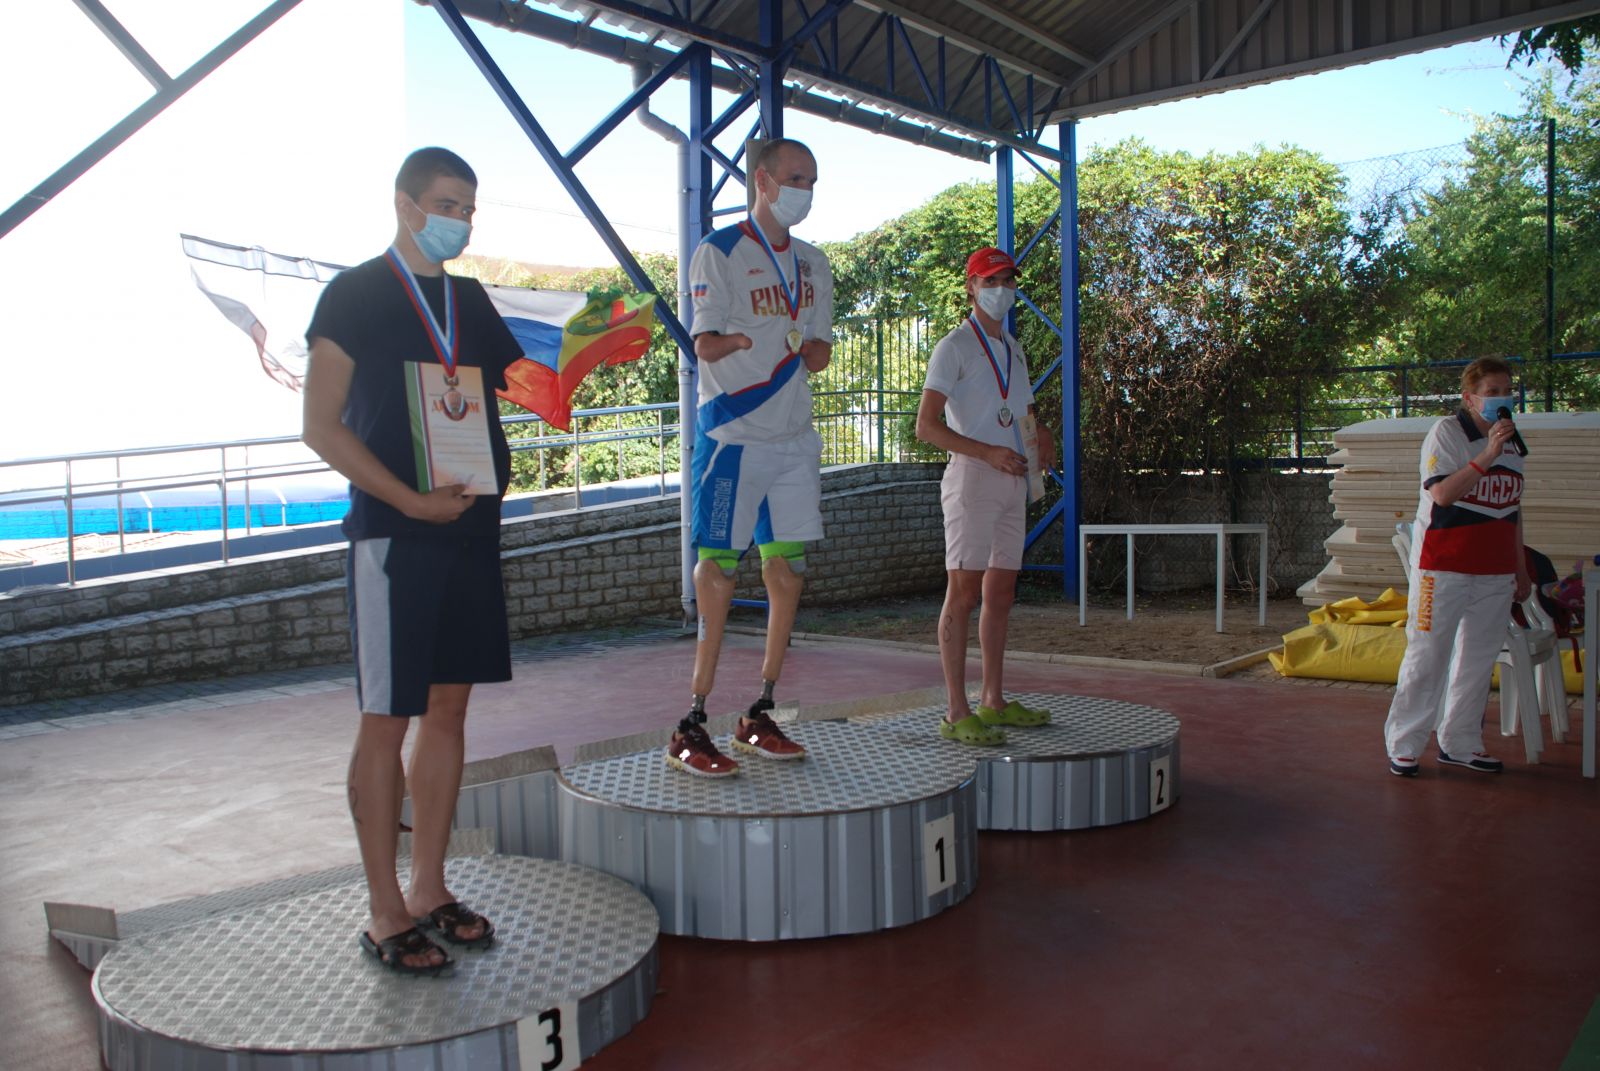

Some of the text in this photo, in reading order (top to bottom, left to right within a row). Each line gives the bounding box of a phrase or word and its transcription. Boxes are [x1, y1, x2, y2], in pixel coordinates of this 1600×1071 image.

[1417, 575, 1435, 632] RUSSIA
[1156, 768, 1164, 806] 2
[935, 836, 945, 883] 1
[538, 1007, 563, 1071] 3
